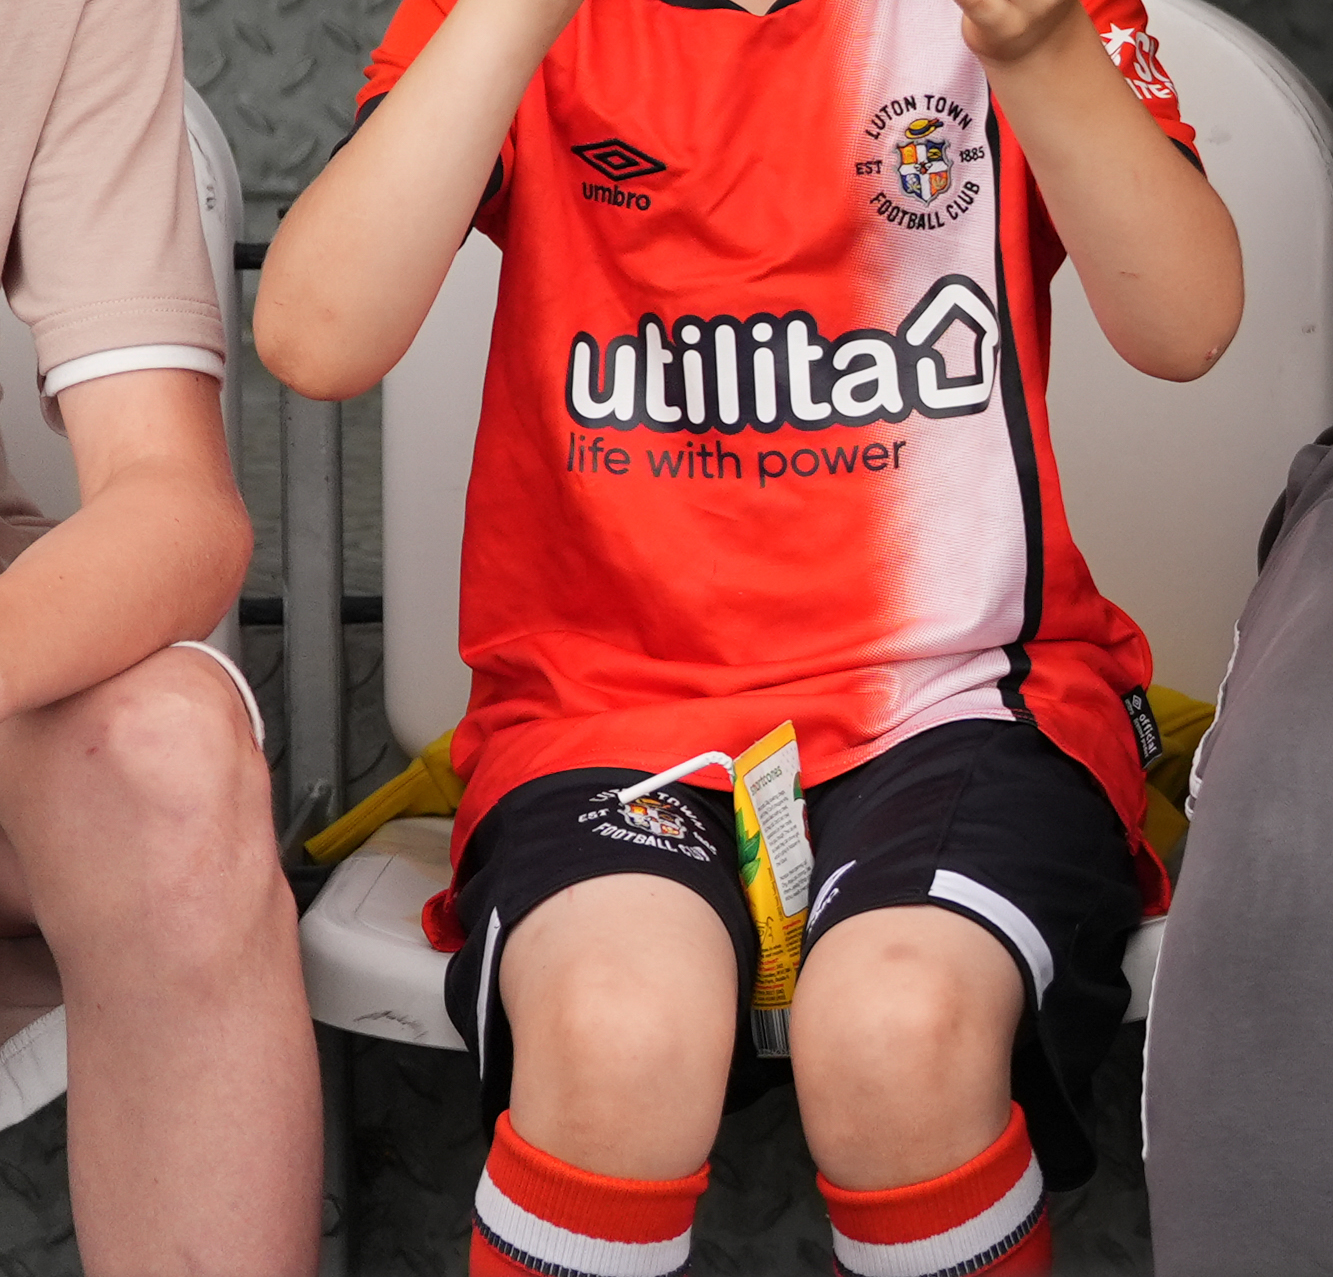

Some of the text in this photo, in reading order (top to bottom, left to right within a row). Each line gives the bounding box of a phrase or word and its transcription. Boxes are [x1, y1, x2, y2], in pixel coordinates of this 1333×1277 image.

[865, 94, 973, 140] LUTON TOWN
[855, 159, 883, 175] EST
[959, 146, 986, 163] 1885
[582, 180, 652, 212] umbro
[869, 180, 980, 230] FOOTBALL CLUB
[571, 319, 903, 425] utilita
[566, 431, 907, 489] life with power
[1139, 713, 1158, 754] official
[591, 822, 678, 853] FOOTBALL
